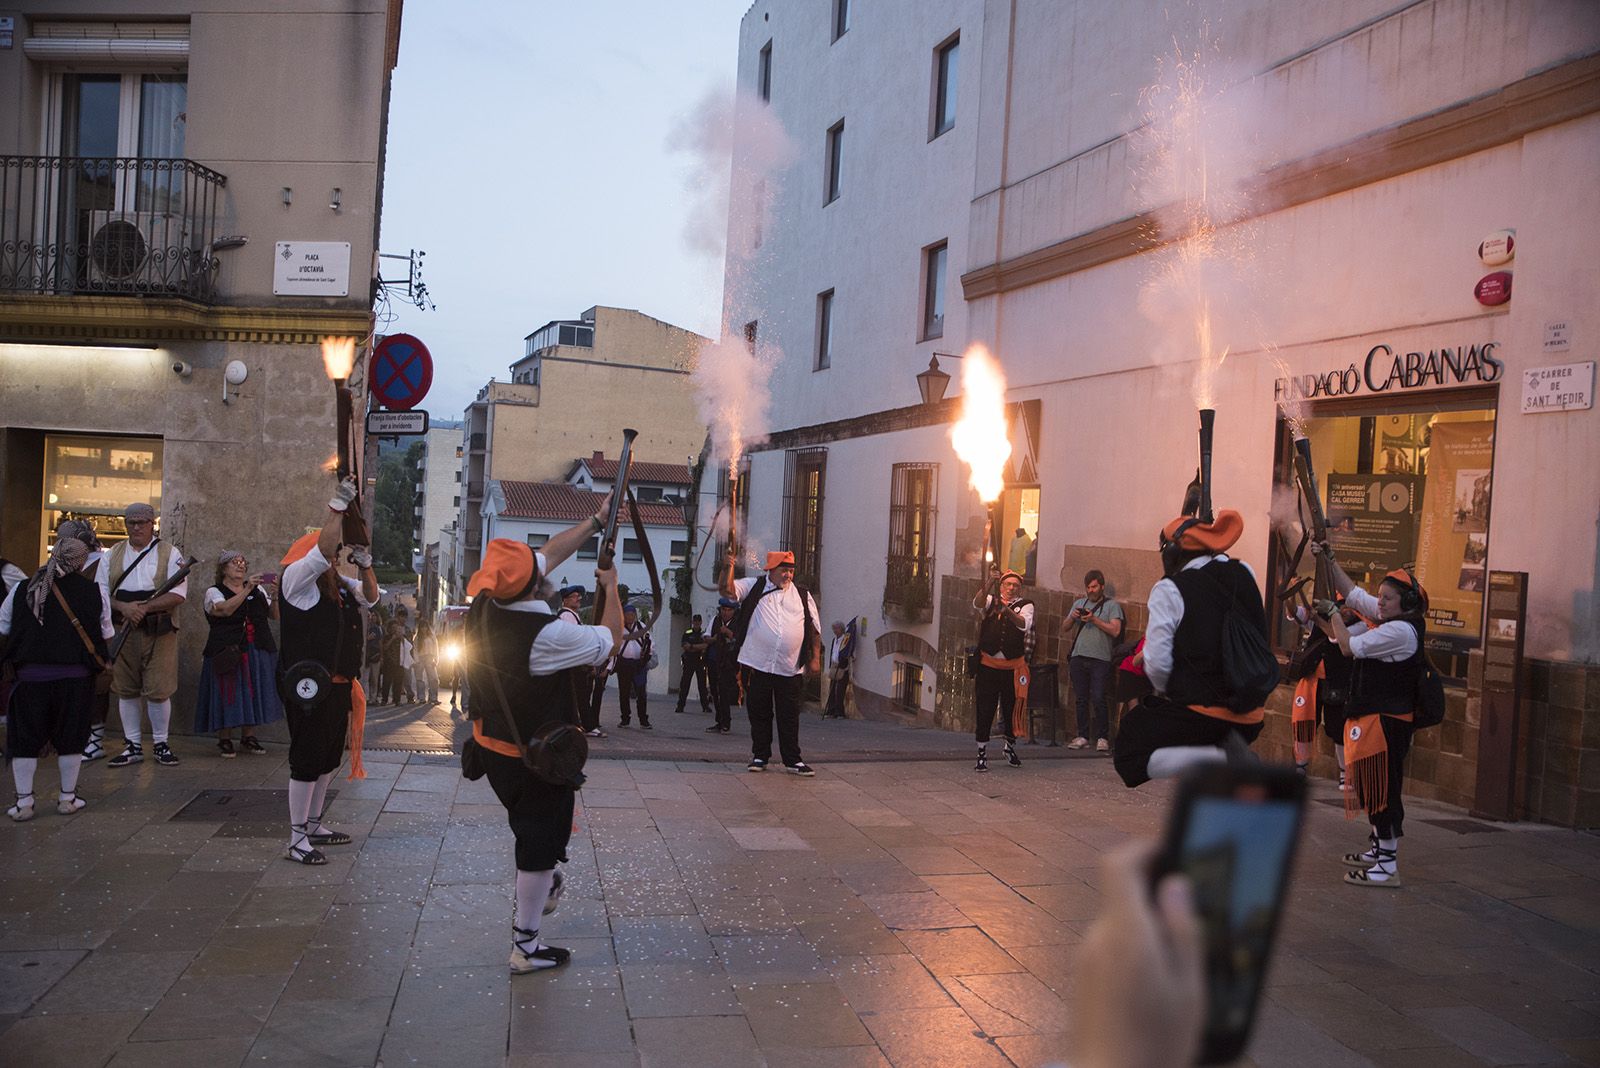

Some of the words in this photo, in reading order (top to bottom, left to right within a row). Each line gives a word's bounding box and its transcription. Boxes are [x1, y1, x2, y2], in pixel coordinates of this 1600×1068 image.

[1541, 368, 1572, 379] CARRER
[1550, 381, 1560, 391] DE
[1527, 395, 1550, 408] SANT
[1556, 392, 1584, 406] MEDIR
[1366, 481, 1410, 513] 10
